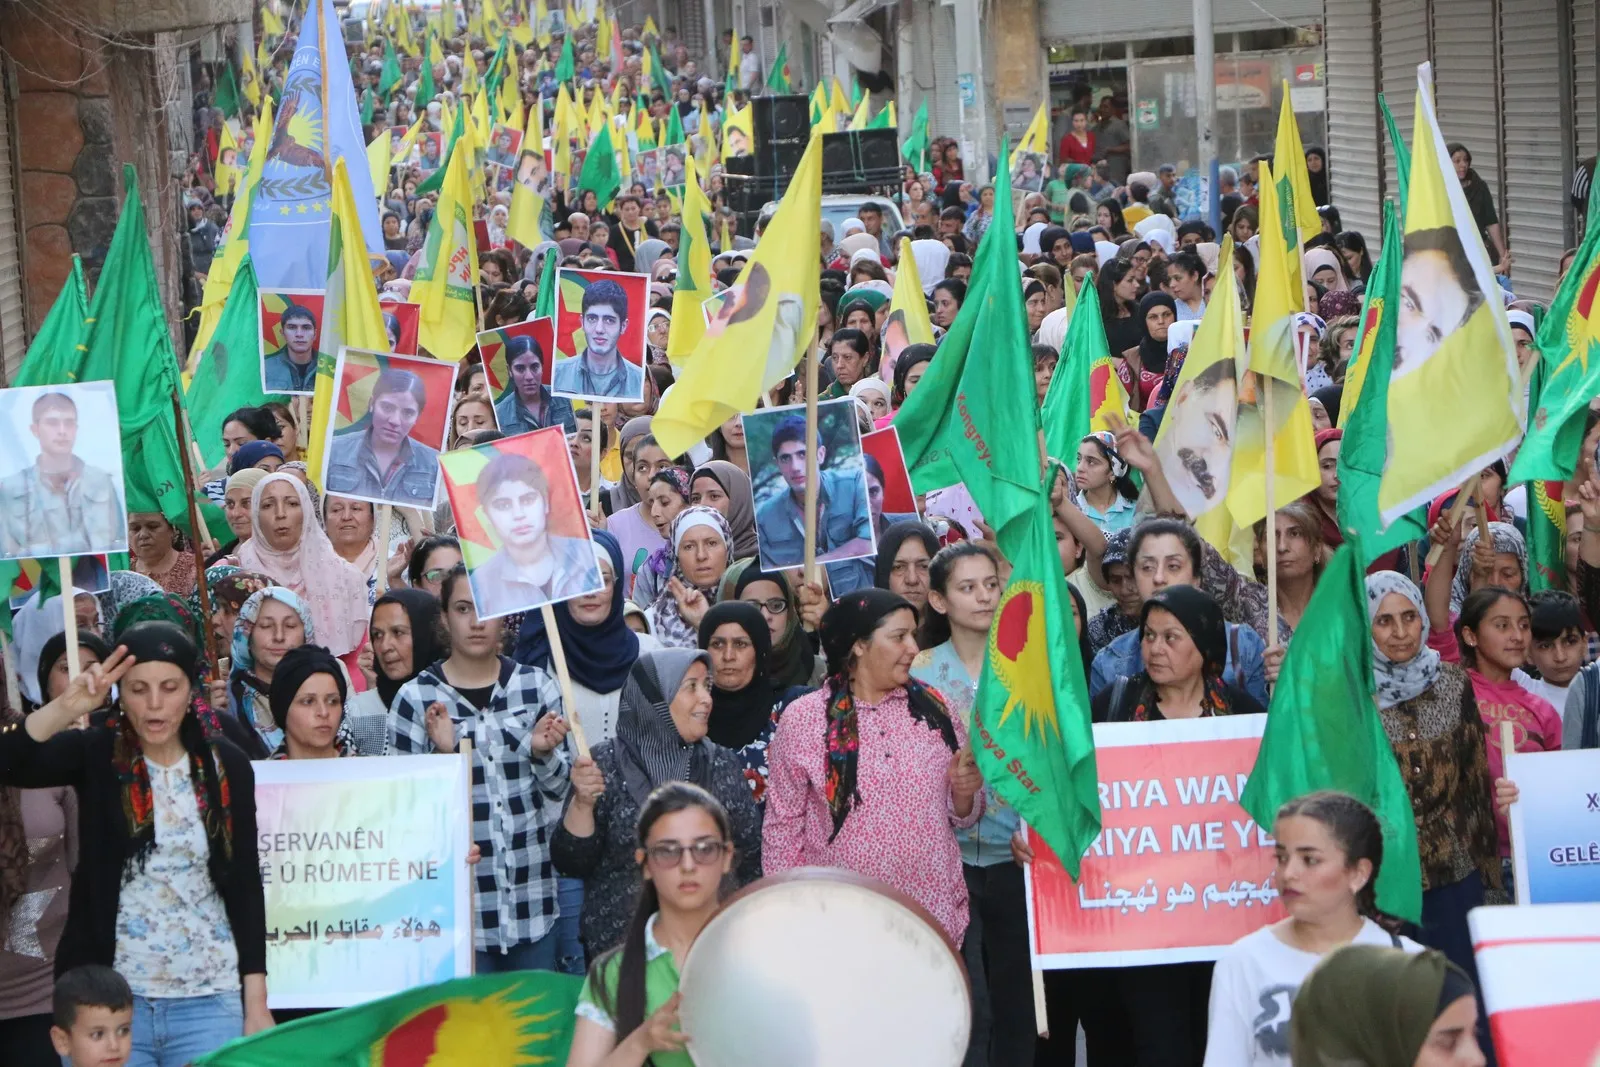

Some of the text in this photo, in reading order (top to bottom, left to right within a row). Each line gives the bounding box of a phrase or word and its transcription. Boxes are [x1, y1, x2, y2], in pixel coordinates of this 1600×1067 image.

[1007, 758, 1041, 794] Star
[1171, 821, 1225, 851] ME
[281, 861, 295, 883] Û
[304, 858, 400, 883] RÛMETÊ
[408, 860, 438, 880] NE
[1079, 878, 1159, 914] نهجنا
[1163, 882, 1196, 911] هو
[324, 918, 384, 945] مقاتلو
[392, 917, 441, 942] هؤلاء
